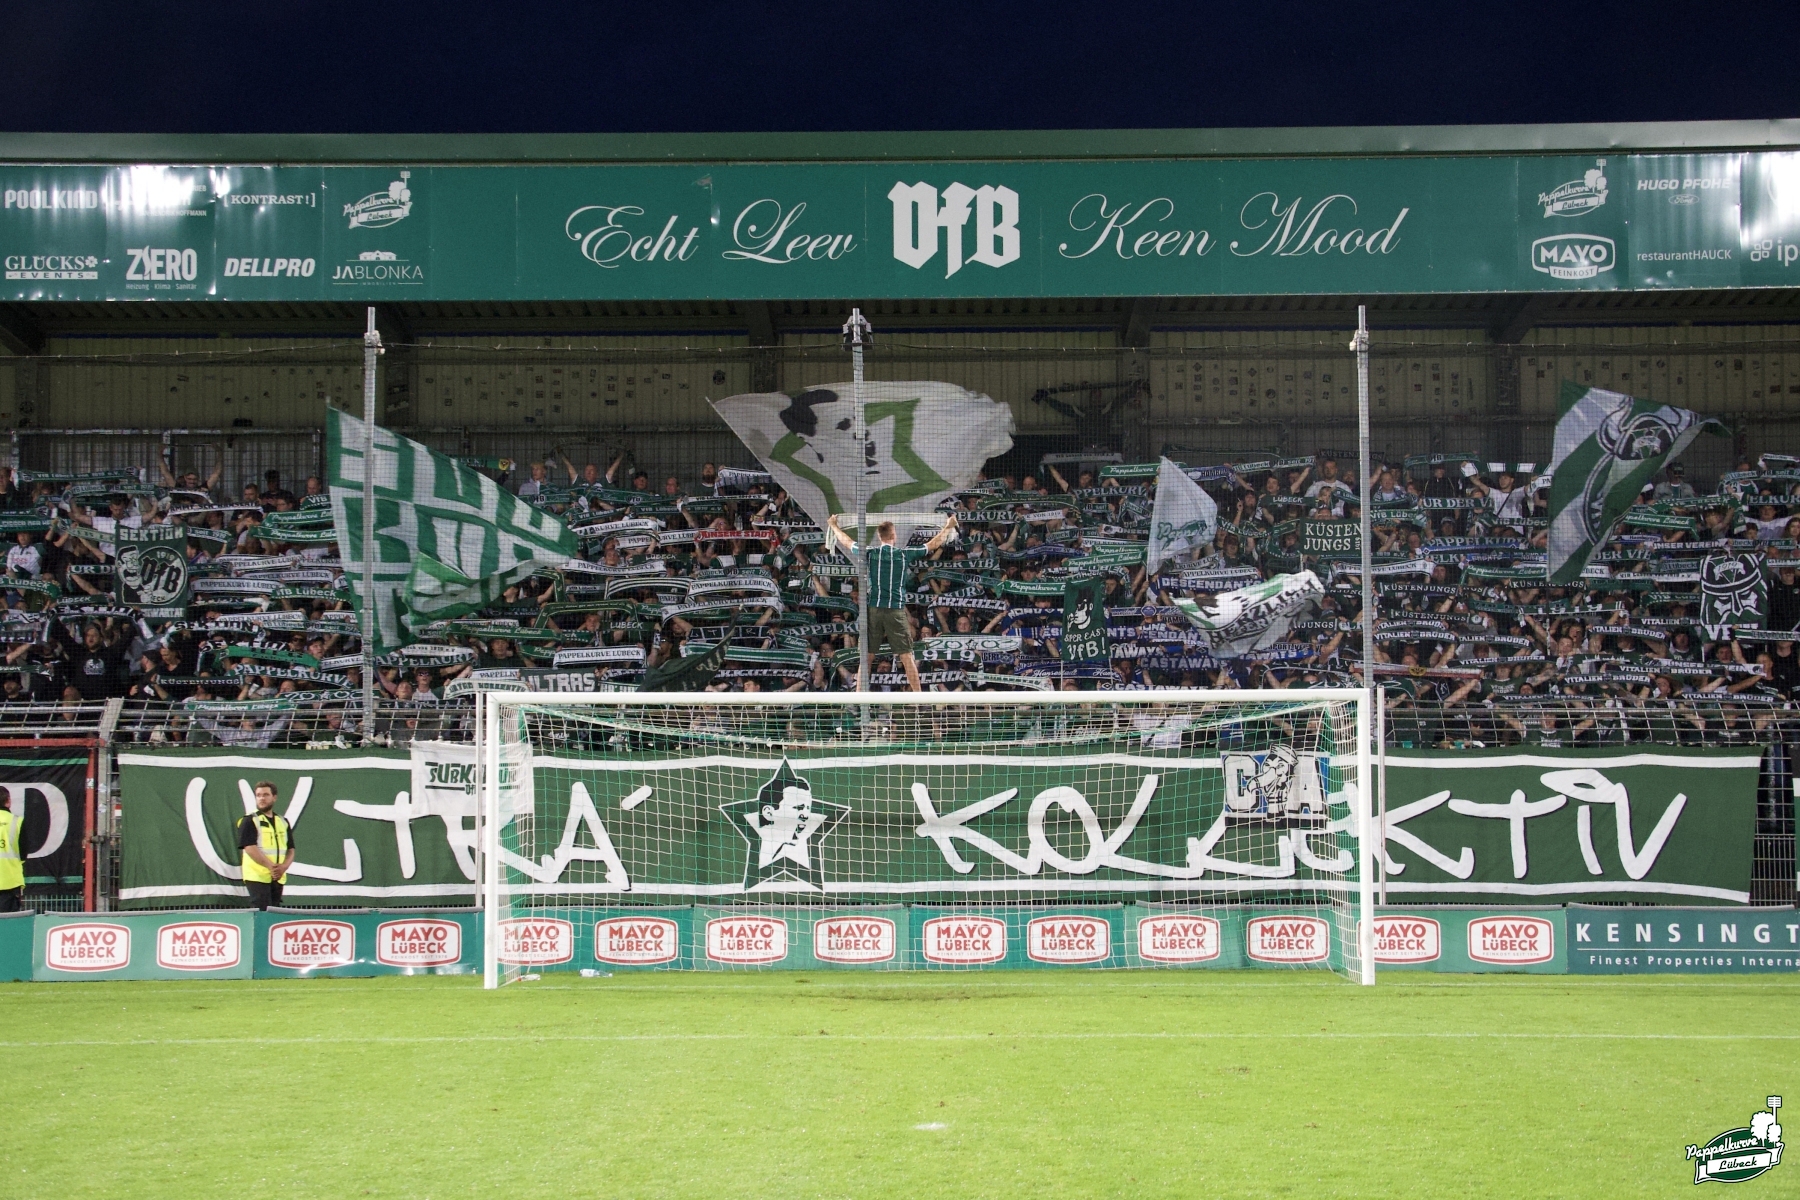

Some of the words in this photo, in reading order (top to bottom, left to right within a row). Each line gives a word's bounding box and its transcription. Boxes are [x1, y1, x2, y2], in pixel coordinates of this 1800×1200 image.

[1637, 178, 1680, 191] HUGO
[1682, 178, 1731, 190] PFOHE
[887, 181, 1020, 280] VfB
[1059, 193, 1216, 260] Keen
[1230, 192, 1410, 258] Mood
[565, 205, 699, 269] Echt
[722, 199, 858, 264] Leev
[1540, 244, 1608, 263] MAYO
[1637, 250, 1732, 261] restaurantHAUCK
[5, 256, 85, 271] GLÜCKS
[224, 258, 316, 277] DELLPRO
[332, 265, 424, 280] JABLONKA
[1553, 267, 1595, 278] FEINKOST
[1513, 518, 1548, 526] Lübec
[1305, 522, 1362, 537] KÜSTEN
[1303, 538, 1351, 551] JUNGS
[1685, 541, 1719, 549] VEREIN
[815, 553, 846, 565] NUR
[296, 588, 337, 597] Lübeck
[691, 580, 742, 591] PAPPELKURVE
[743, 581, 772, 589] LÜBECK
[1374, 631, 1411, 640] VITALIEN
[1419, 631, 1456, 641] BRÜDER
[1494, 636, 1531, 647] BRÜDER
[558, 651, 612, 660] PAPPELKURVE
[612, 649, 642, 657] LÜBECK
[923, 650, 976, 662] 919
[1619, 665, 1661, 674] VITALIEN
[1564, 675, 1603, 684] VITALIEN
[1612, 674, 1650, 683] BRÜDER
[1733, 693, 1774, 702] BRÜDER
[172, 929, 227, 944] MAYO
[283, 928, 341, 943] MAYO
[391, 926, 448, 942] MAYO
[504, 925, 560, 940] MAYO
[609, 924, 665, 939] MAYO
[720, 924, 775, 938] MAYO
[827, 924, 882, 938] MAYO
[937, 924, 992, 938] MAYO
[1041, 923, 1097, 938] MAYO
[1152, 923, 1206, 937] MAYO
[1260, 923, 1316, 938] MAYO
[1373, 923, 1427, 938] MAYO
[1482, 924, 1539, 939] MAYO
[1576, 923, 1799, 944] KENSINGT
[61, 931, 117, 946] MAYO
[1590, 955, 1638, 965] Finest
[1648, 955, 1732, 968] Properties
